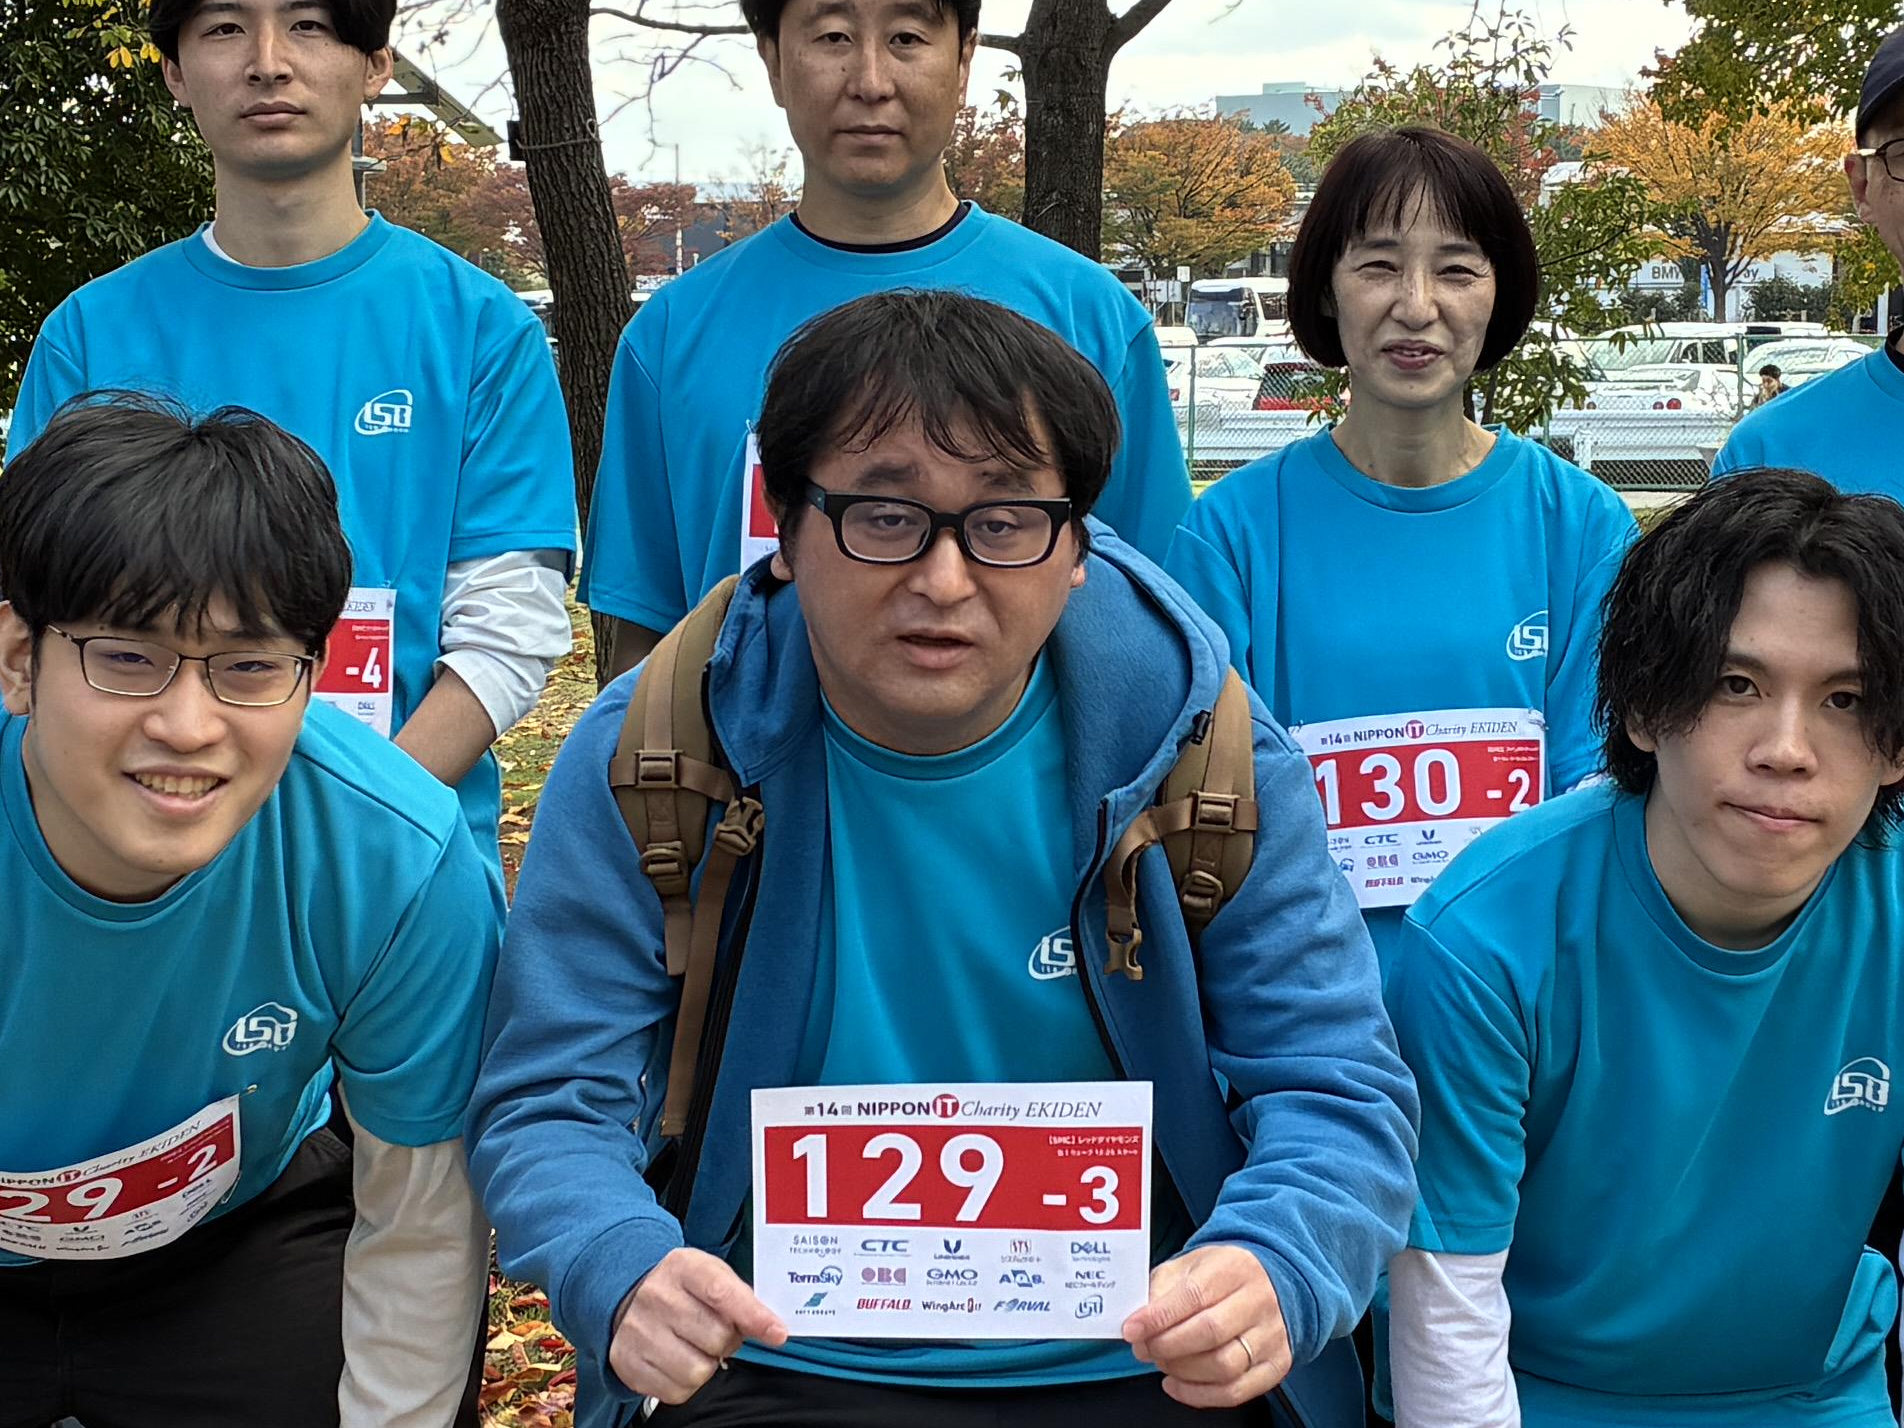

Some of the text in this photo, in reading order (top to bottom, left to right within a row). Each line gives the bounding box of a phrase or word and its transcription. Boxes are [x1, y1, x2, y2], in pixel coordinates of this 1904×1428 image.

[1353, 727, 1405, 742] NIPPON
[1426, 722, 1467, 737] Charity
[1470, 721, 1517, 735] EKIDEN
[1315, 748, 1462, 825] 130
[1364, 834, 1398, 845] CTC
[858, 1101, 930, 1116] NIPPON
[961, 1100, 1020, 1121] Charity
[1025, 1101, 1102, 1118] EKIDEN
[792, 1133, 1005, 1222] 129
[793, 1234, 838, 1245] SAISON
[861, 1239, 909, 1252] CTC
[1070, 1241, 1111, 1254] DELL
[926, 1268, 978, 1280] GMO
[1075, 1270, 1106, 1280] NEC
[857, 1298, 913, 1311] BUFFALO
